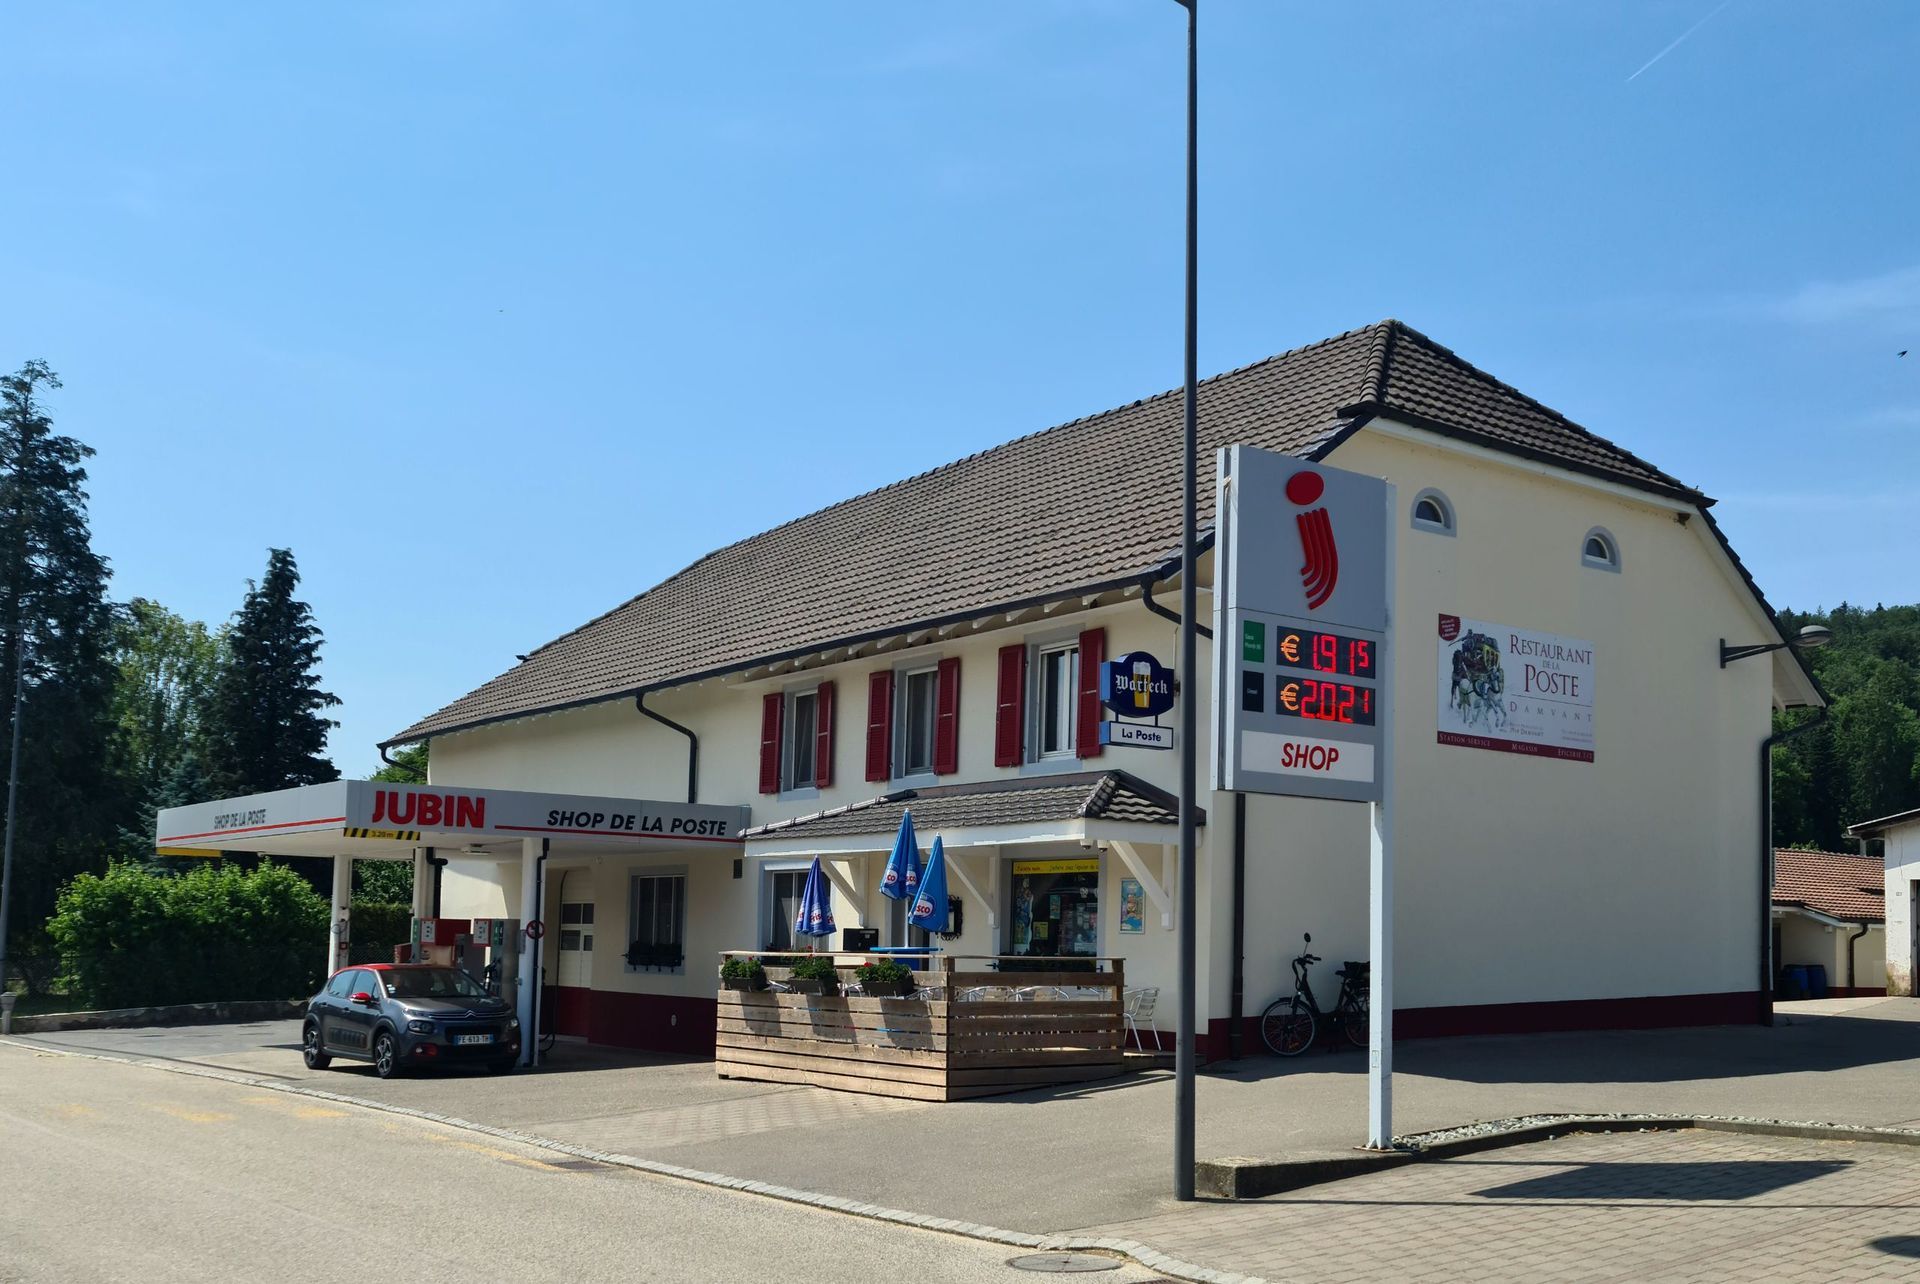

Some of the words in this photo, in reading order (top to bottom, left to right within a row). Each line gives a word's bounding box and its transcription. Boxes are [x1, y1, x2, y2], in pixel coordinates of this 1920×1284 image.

[1510, 634, 1592, 665] RESTAURANT
[1115, 674, 1168, 694] Warteck
[1524, 663, 1579, 697] POSTE
[1510, 701, 1592, 722] DAMVANT
[1121, 728, 1132, 739] La
[1135, 730, 1161, 742] Poste
[1281, 742, 1339, 771] SHOP
[1511, 743, 1538, 753] MAGASIN
[214, 814, 230, 830] SHOP
[230, 813, 239, 828] DE
[239, 811, 249, 826] LA
[248, 809, 266, 825] POSTE
[372, 790, 485, 829] JUBIN
[547, 810, 605, 828] SHOP
[610, 814, 636, 830] DE
[641, 816, 663, 832] LA
[670, 818, 727, 836] POSTE
